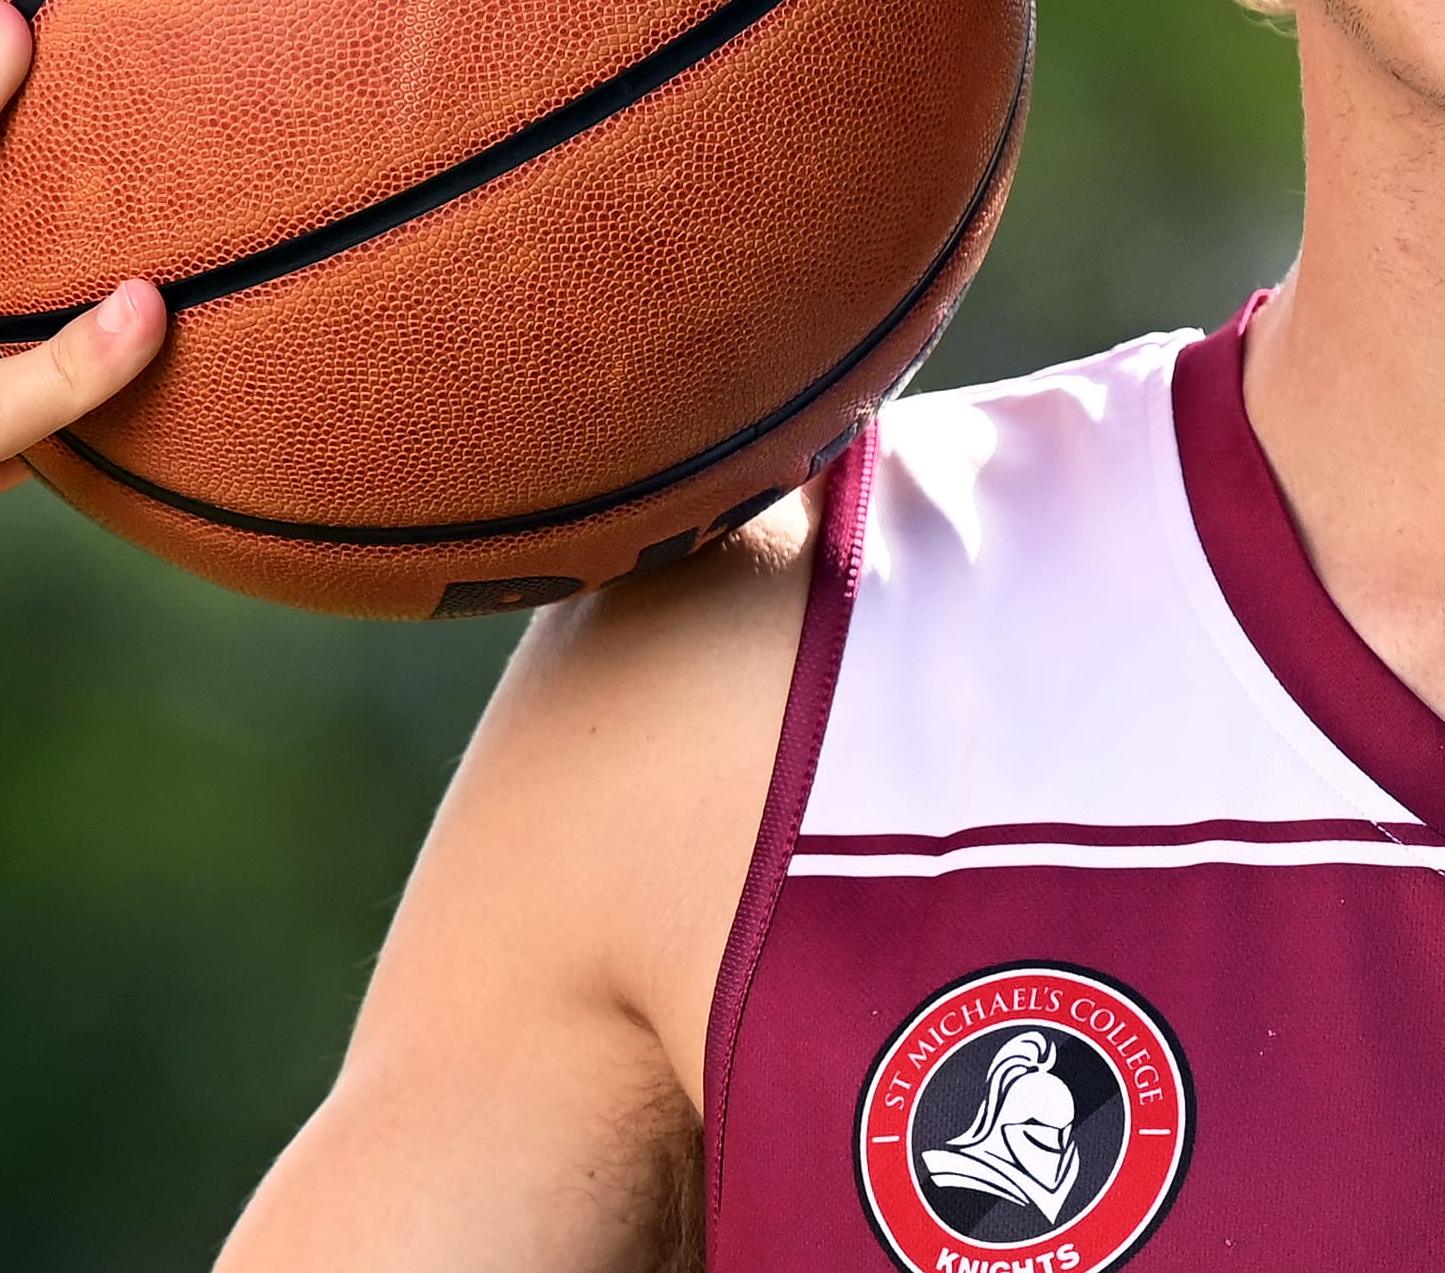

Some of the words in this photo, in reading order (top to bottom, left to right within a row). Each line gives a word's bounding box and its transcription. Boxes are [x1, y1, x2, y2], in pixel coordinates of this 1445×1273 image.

[884, 1070, 913, 1111] ST
[907, 986, 1063, 1070] MICHAEL'S
[1070, 996, 1163, 1105] COLLEGE
